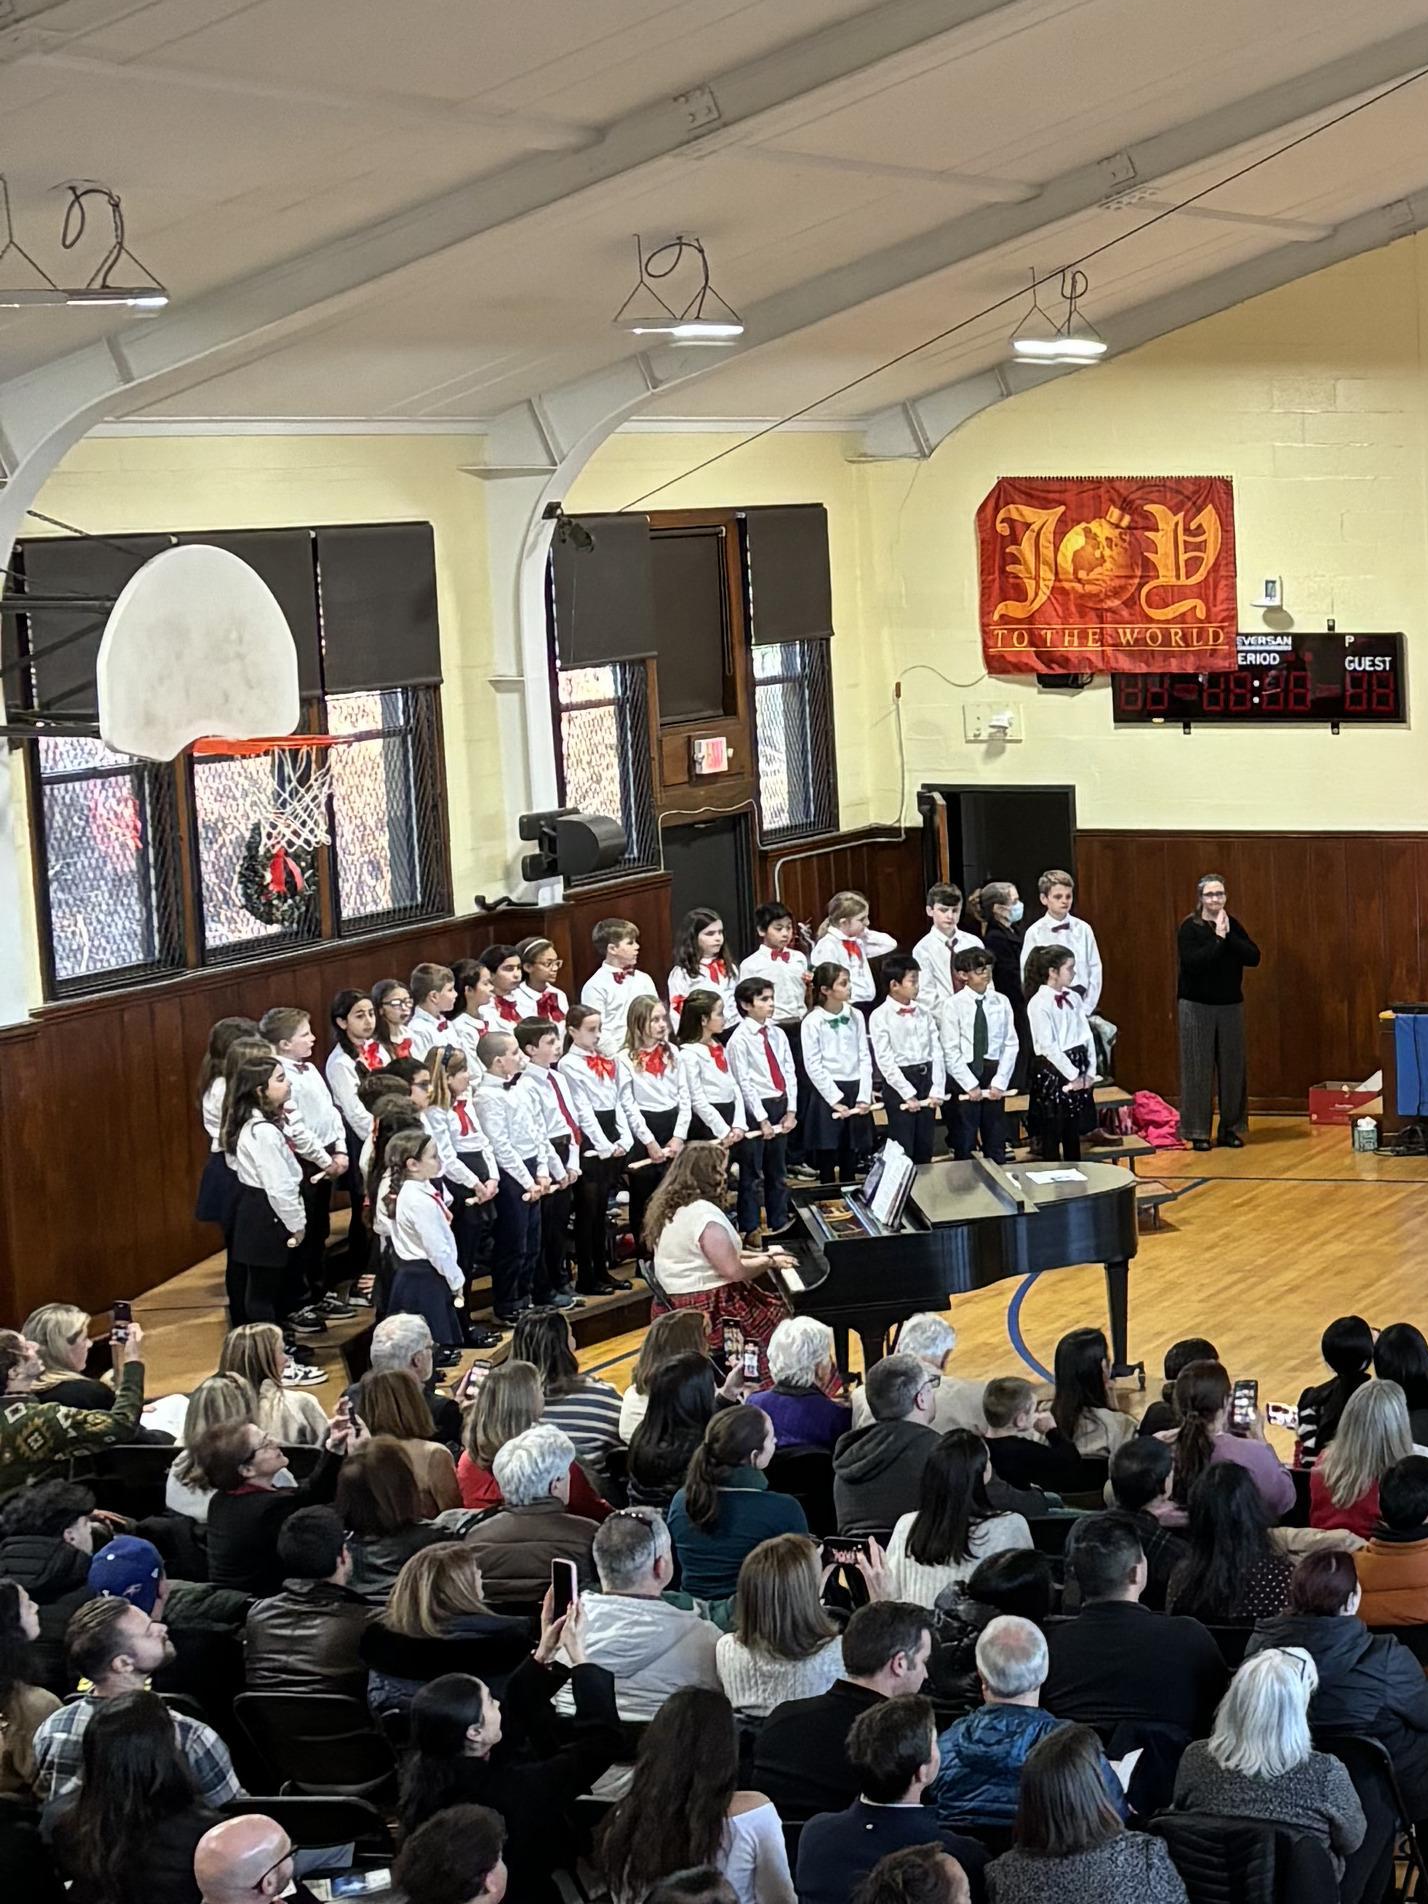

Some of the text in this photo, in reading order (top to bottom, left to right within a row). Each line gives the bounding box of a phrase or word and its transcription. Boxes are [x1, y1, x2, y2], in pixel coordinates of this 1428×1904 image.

[993, 627, 1224, 647] TO THE WORLD
[1237, 652, 1280, 665] ERIOD
[1345, 656, 1392, 671] GUEST
